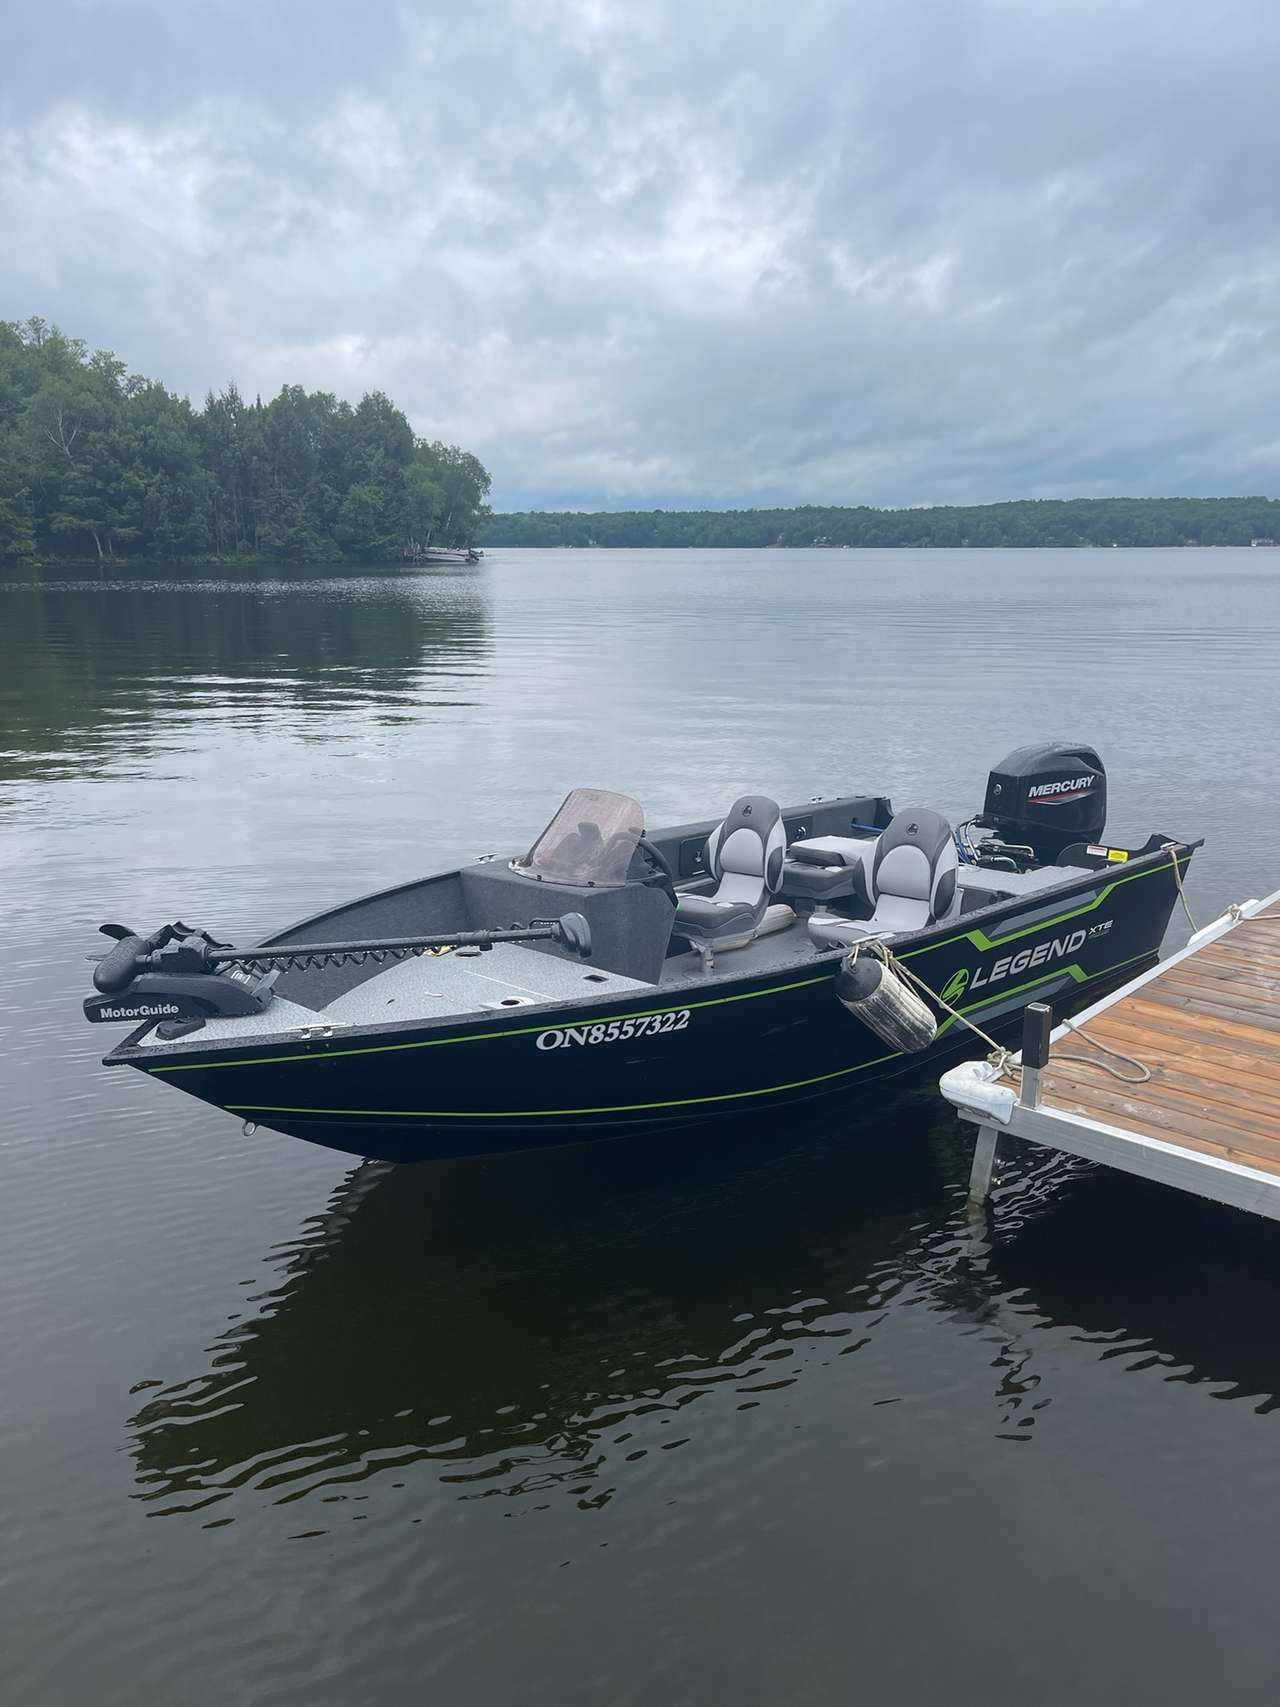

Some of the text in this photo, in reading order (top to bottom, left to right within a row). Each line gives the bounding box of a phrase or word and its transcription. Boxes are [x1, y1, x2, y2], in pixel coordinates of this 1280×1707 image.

[1028, 775, 1095, 797] MERCURY
[969, 929, 1088, 990] LEGEND
[100, 1003, 179, 1019] MotorGuide
[535, 1009, 691, 1051] ON8557322
